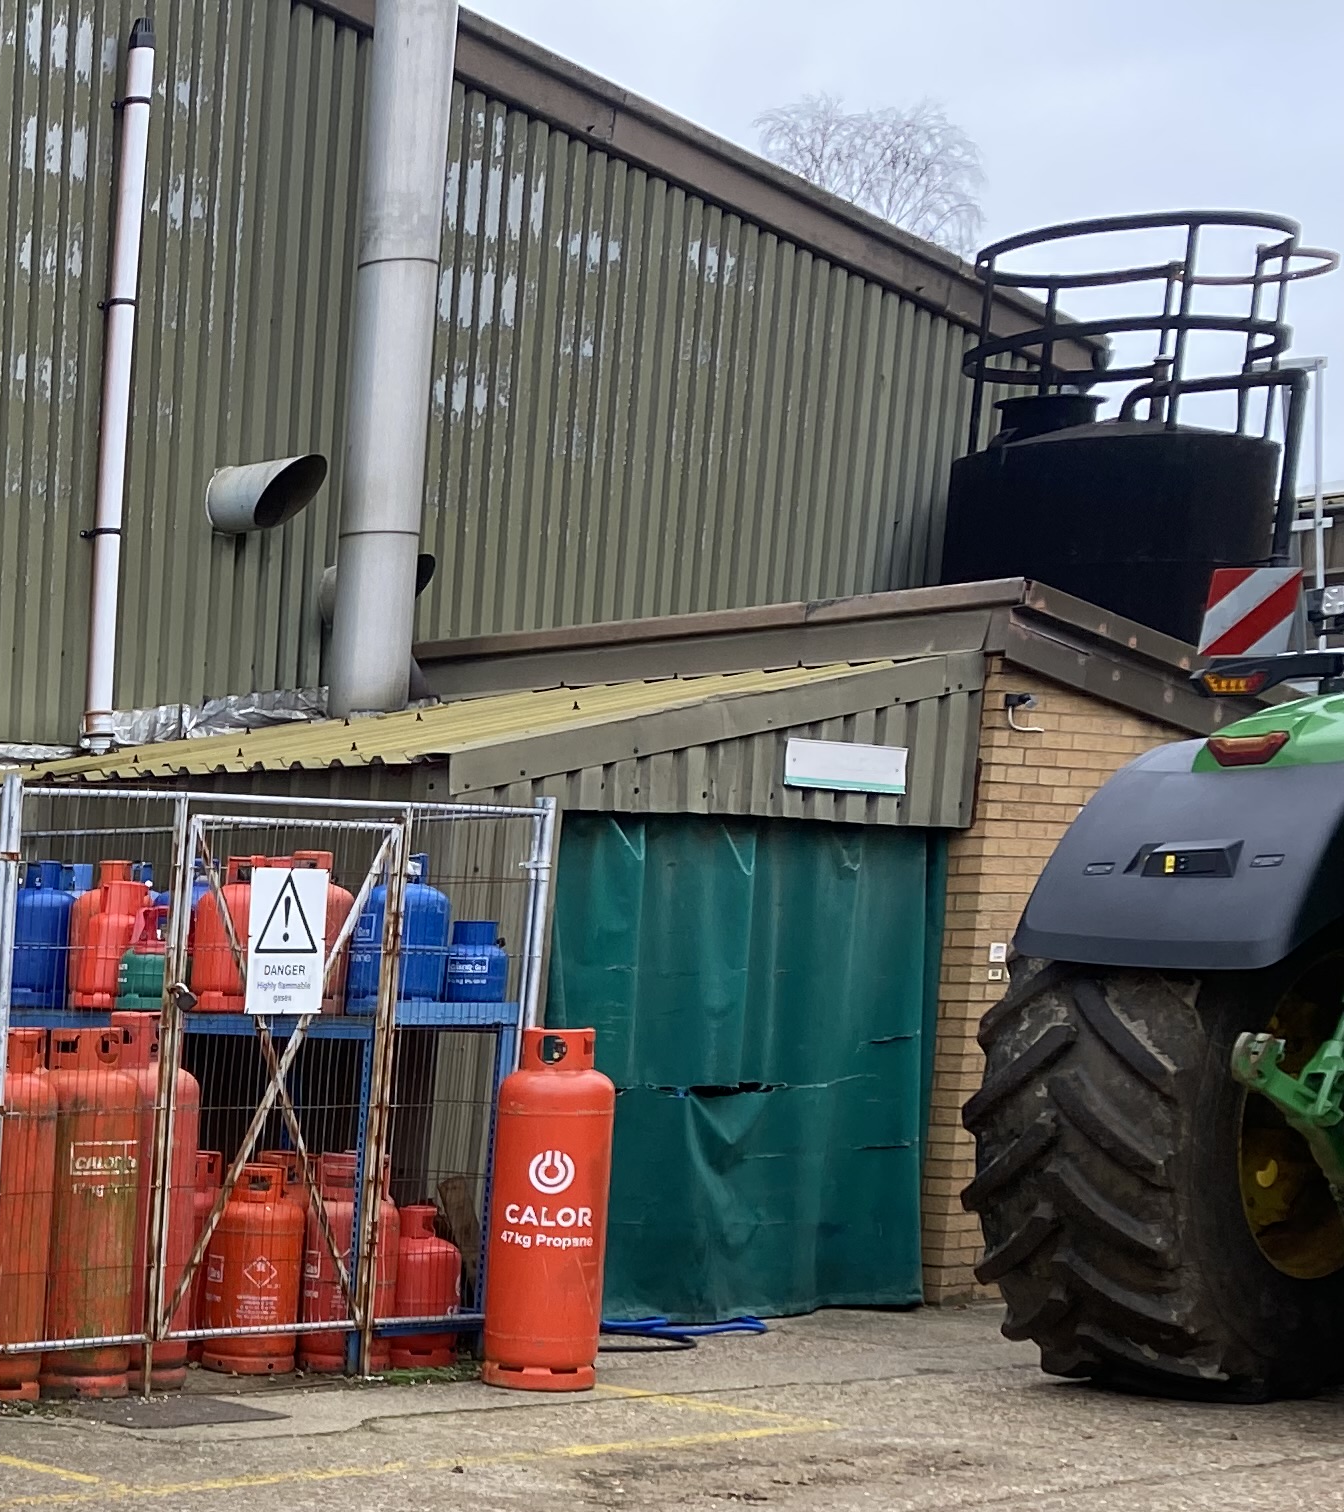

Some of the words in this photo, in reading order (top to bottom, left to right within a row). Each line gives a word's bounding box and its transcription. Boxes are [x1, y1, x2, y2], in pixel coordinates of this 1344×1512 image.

[264, 965, 306, 976] DANGER
[256, 981, 277, 992] Highly
[505, 1204, 593, 1228] CALOR
[500, 1230, 532, 1249] 47kg
[535, 1233, 594, 1251] Propane
